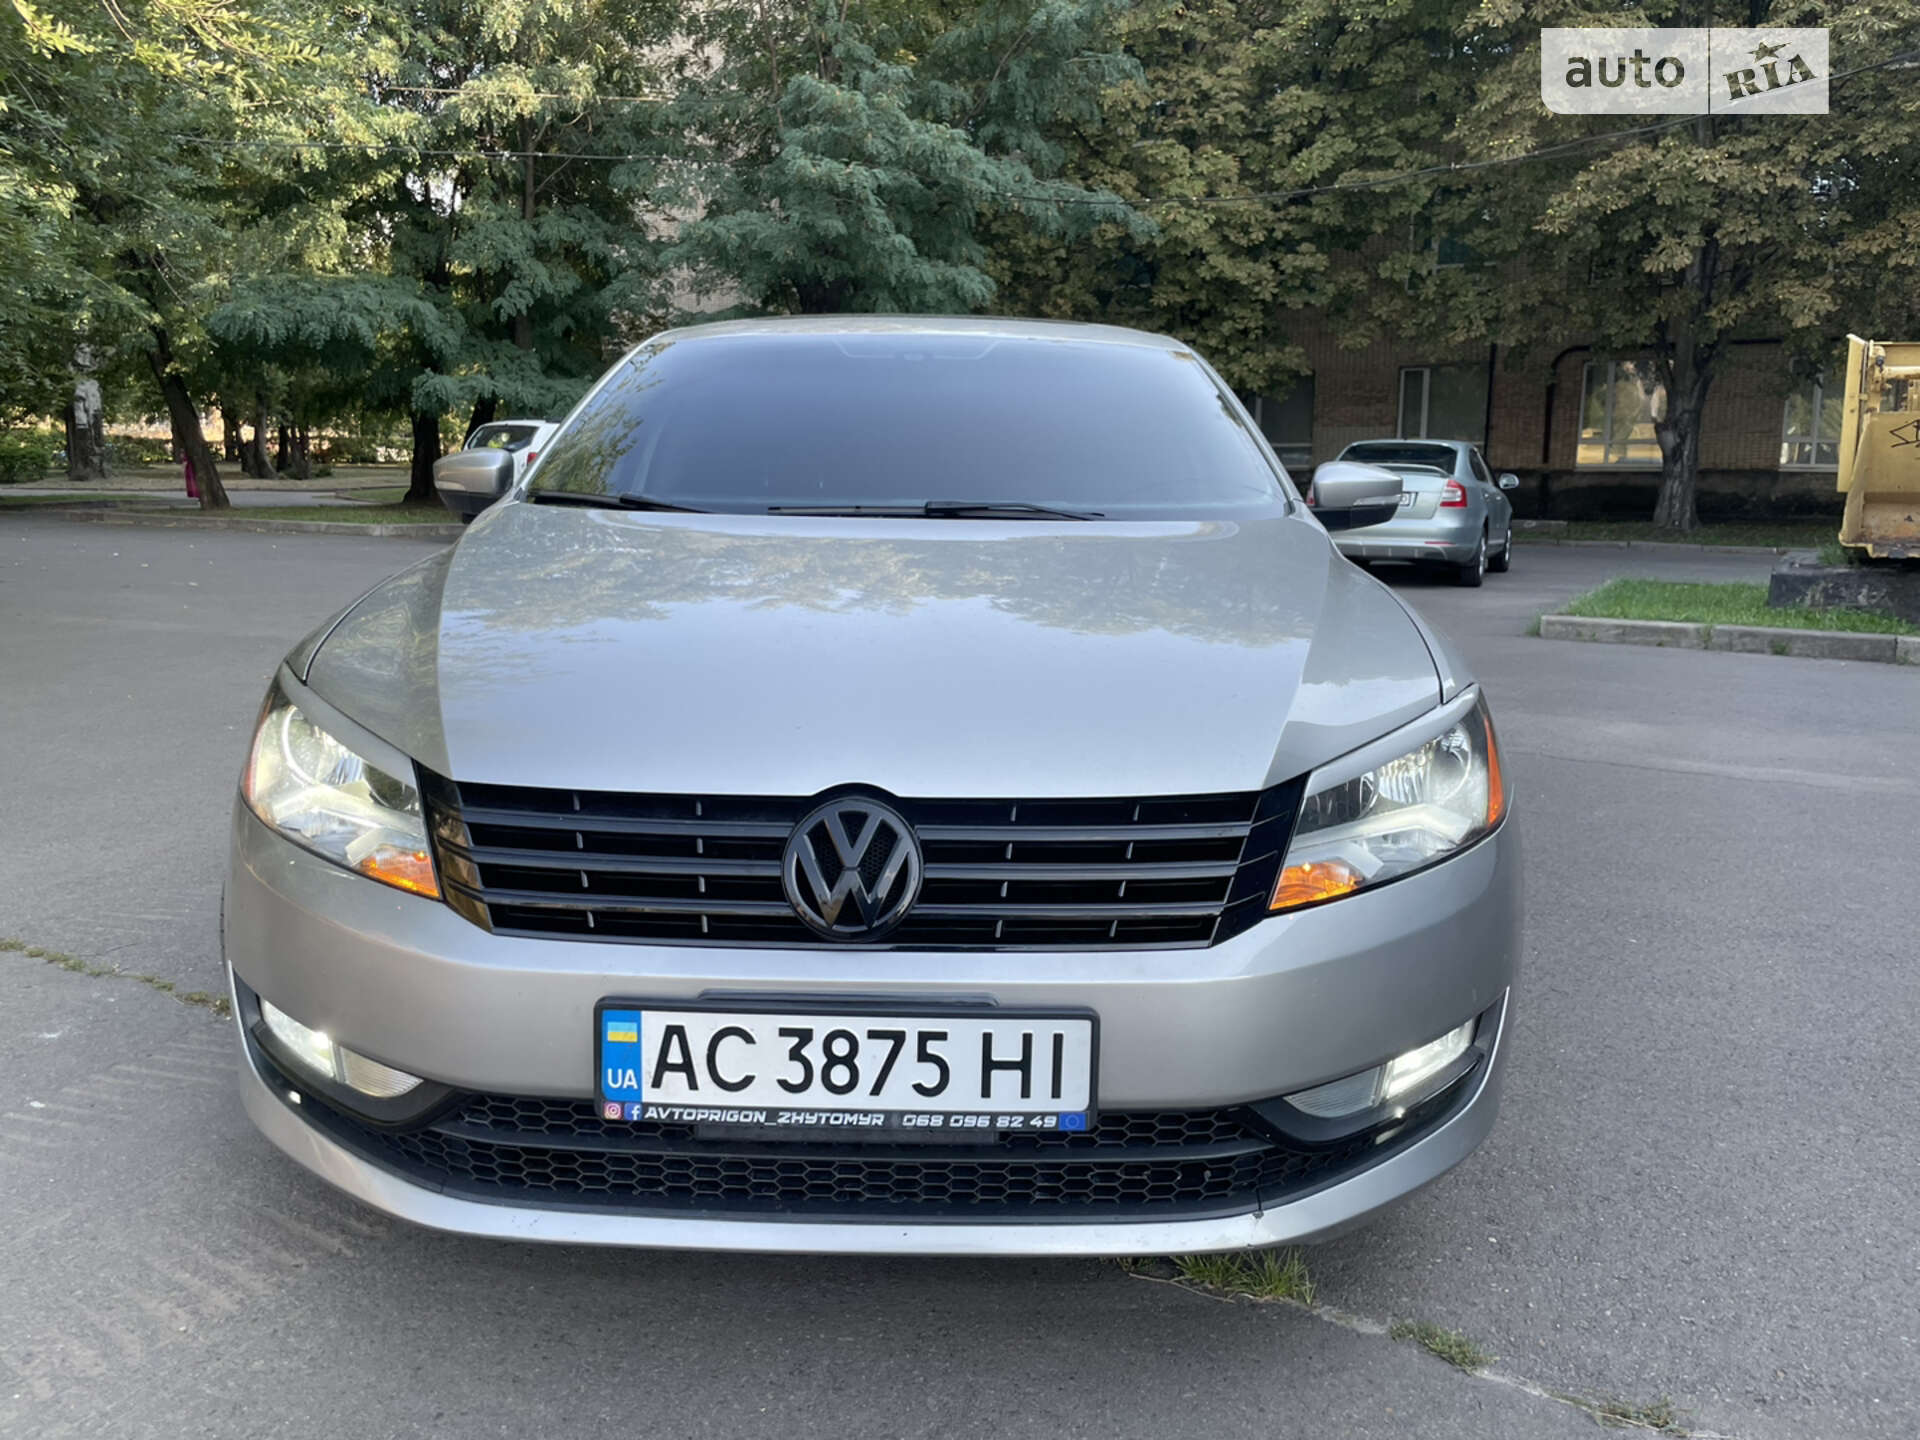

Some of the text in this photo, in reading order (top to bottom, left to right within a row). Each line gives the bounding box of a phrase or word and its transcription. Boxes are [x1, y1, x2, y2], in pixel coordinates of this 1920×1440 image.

[650, 1025, 1063, 1099] AC 3875 HI
[607, 1069, 638, 1090] UA
[902, 1114, 945, 1127] 068
[950, 1115, 991, 1128] 096
[1029, 1116, 1057, 1128] 49
